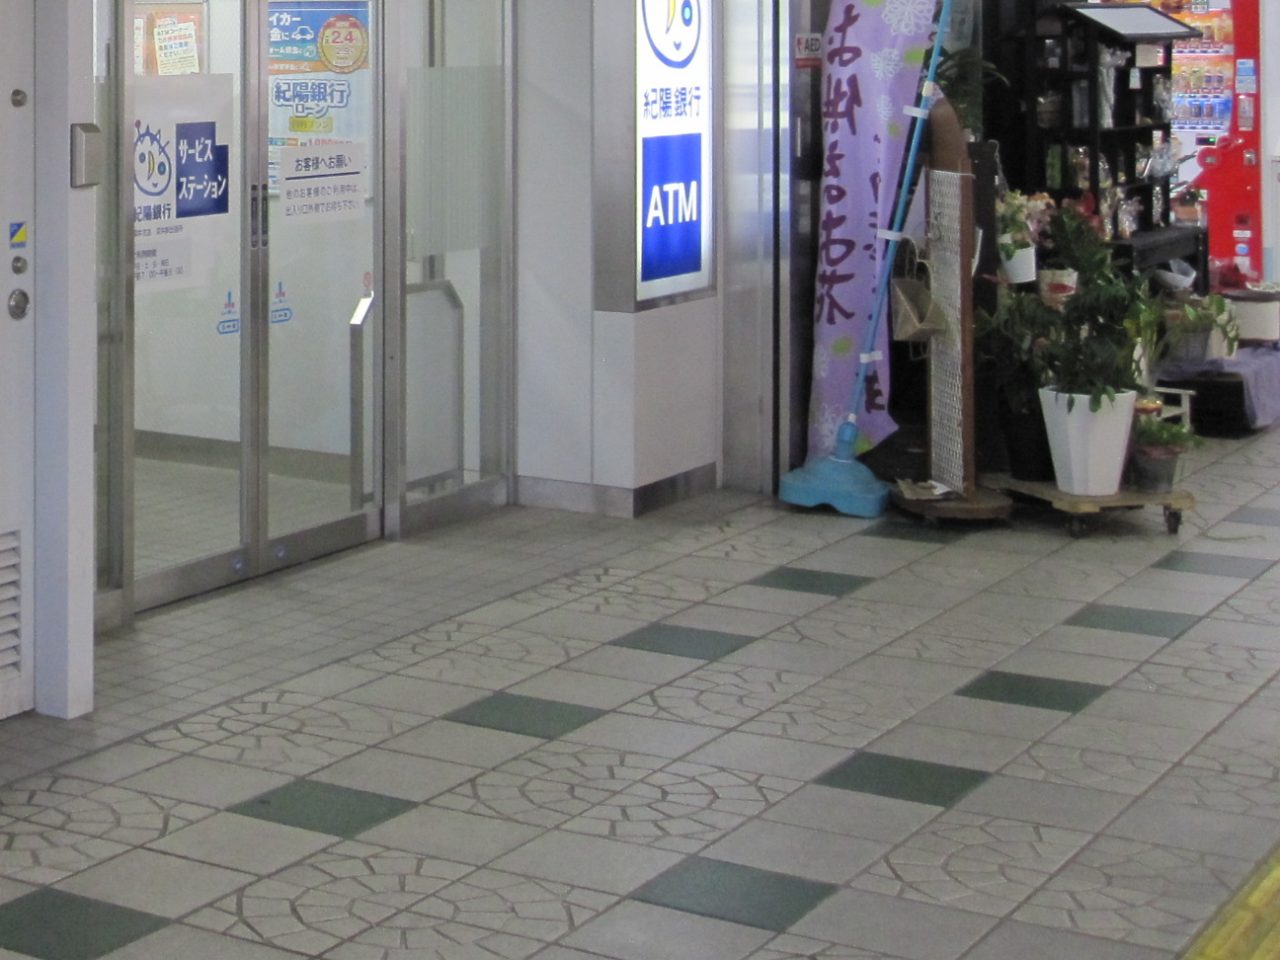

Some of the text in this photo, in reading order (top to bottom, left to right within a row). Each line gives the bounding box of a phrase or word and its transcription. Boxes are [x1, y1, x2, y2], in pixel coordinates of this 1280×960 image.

[804, 38, 821, 52] AED
[274, 81, 347, 104] 紀陽銀行
[643, 86, 701, 120] 紀陽銀行
[295, 103, 327, 115] ローン
[178, 137, 213, 165] サービス
[294, 154, 352, 172] お客様へお願い
[178, 173, 226, 200] ステーション
[646, 181, 697, 228] ATM
